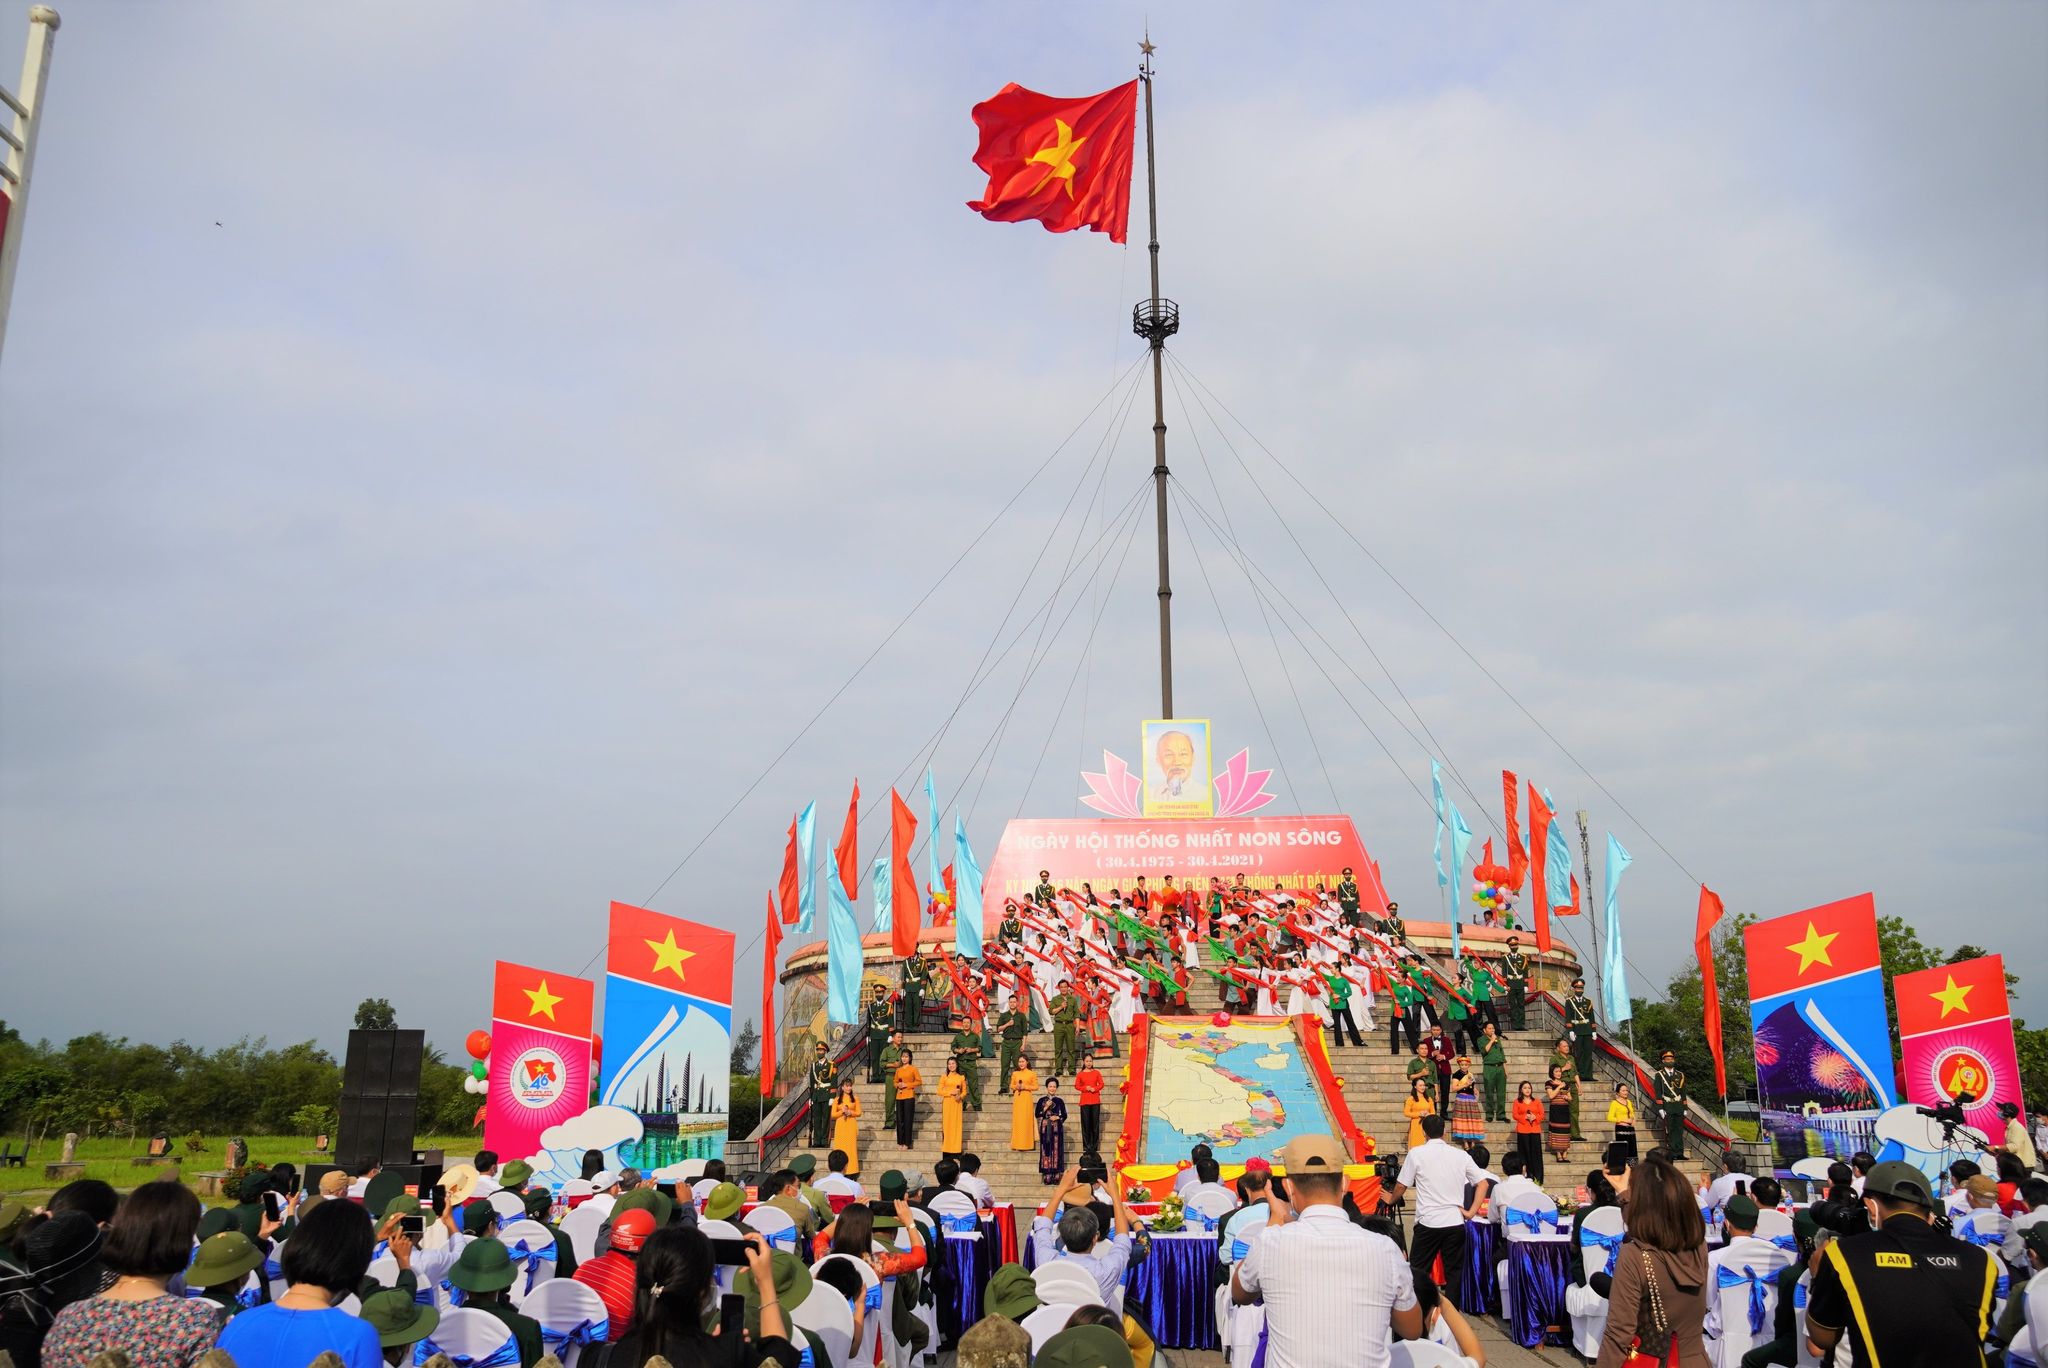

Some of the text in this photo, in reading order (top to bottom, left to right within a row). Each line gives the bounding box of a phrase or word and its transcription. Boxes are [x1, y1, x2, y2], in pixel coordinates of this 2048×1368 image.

[1016, 828, 1342, 853] NGÀY HỘI THỐNG NHẤT NON SÔNG
[1105, 856, 1175, 868] 30.4.1975
[530, 1074, 549, 1089] 46
[1879, 1255, 1884, 1264] I
[1887, 1255, 1907, 1265] AM
